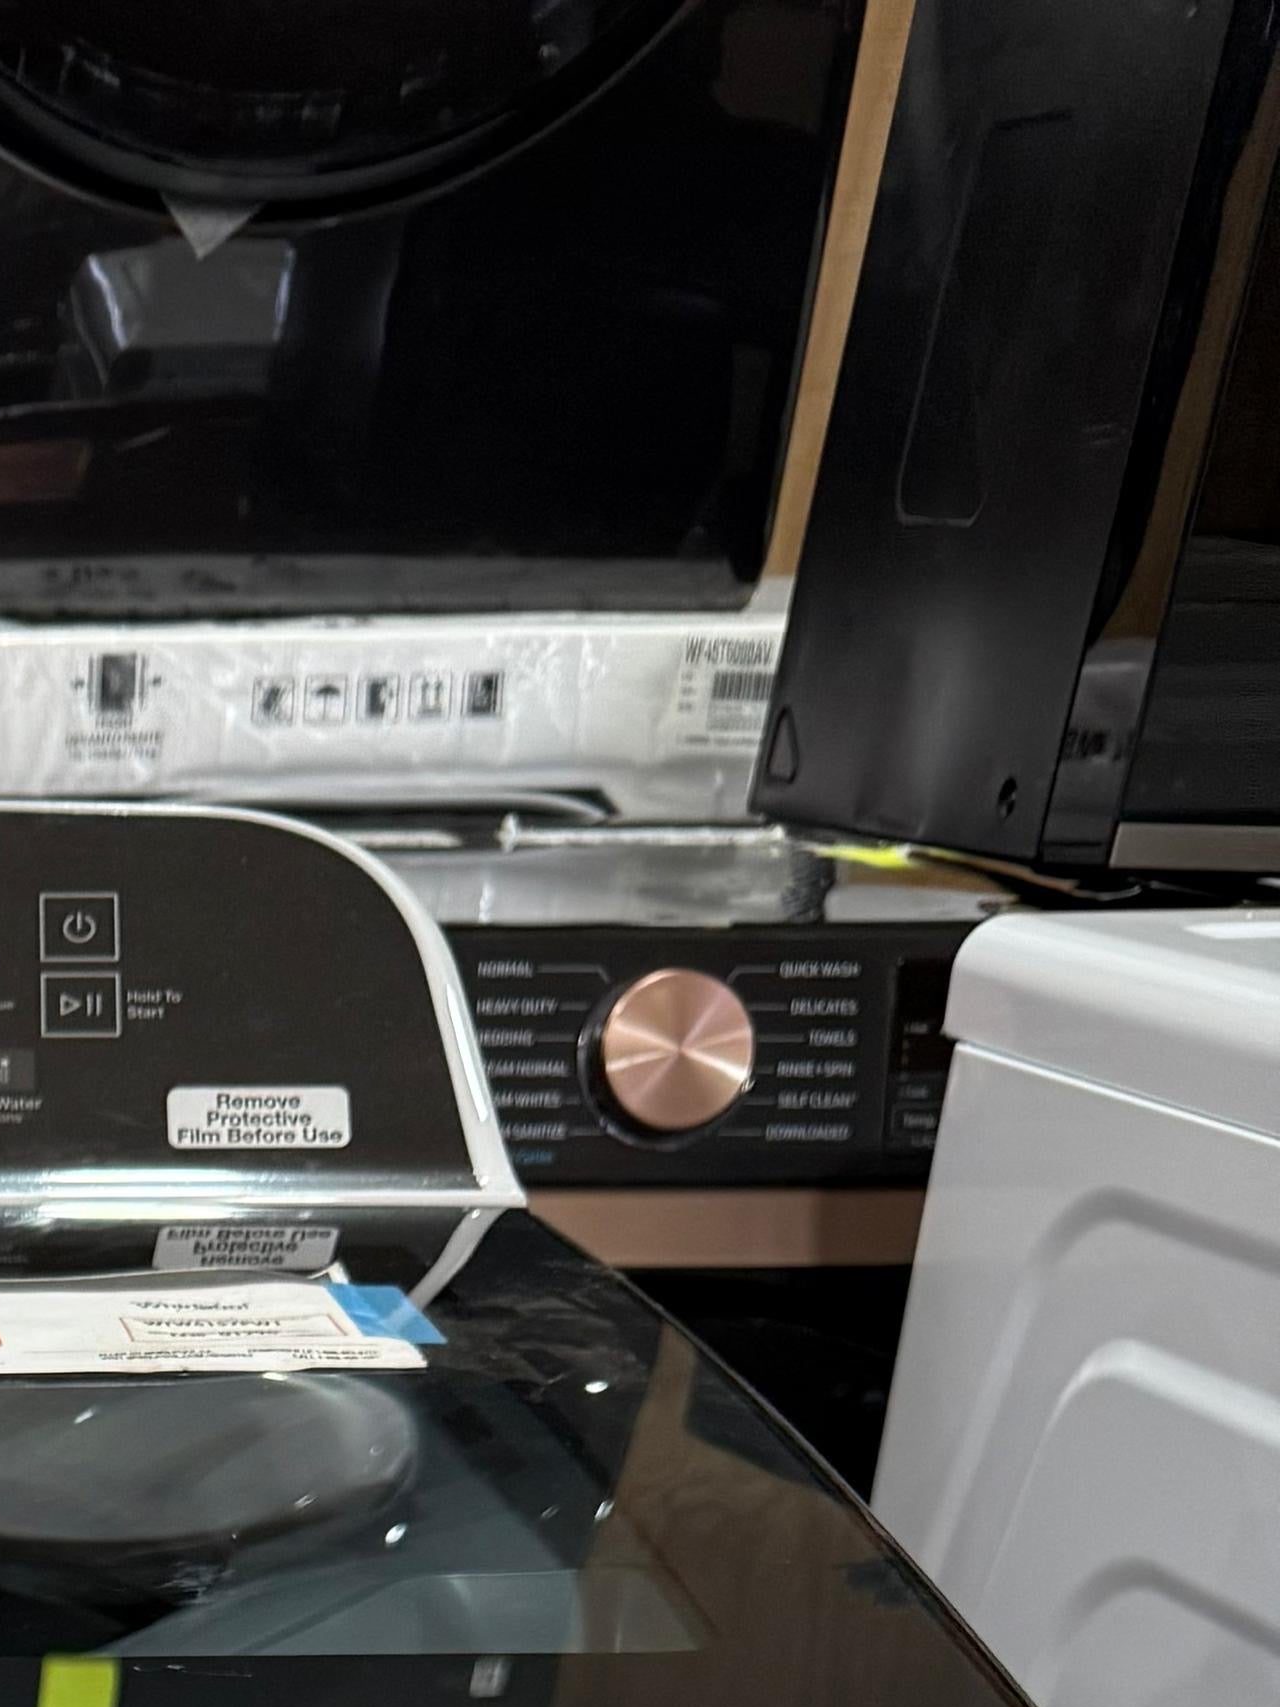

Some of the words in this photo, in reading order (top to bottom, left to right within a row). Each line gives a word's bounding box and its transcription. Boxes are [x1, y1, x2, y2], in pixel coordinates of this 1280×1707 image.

[477, 961, 534, 979] NORMAL
[780, 961, 817, 978] QUICK
[818, 961, 860, 978] WASH
[126, 989, 163, 1004] Hold
[165, 989, 182, 1004] To
[126, 1004, 165, 1020] Start
[476, 999, 518, 1016] HEAVY
[520, 999, 558, 1015] DUTY
[790, 999, 858, 1016] DELICATES
[808, 1030, 857, 1047] TOWELS
[215, 1093, 302, 1110] Remove
[205, 1110, 314, 1127] Protective
[176, 1127, 222, 1144] Film
[227, 1127, 297, 1144] Before
[301, 1127, 344, 1144] Use
[765, 1123, 851, 1140] DOWNLOADED
